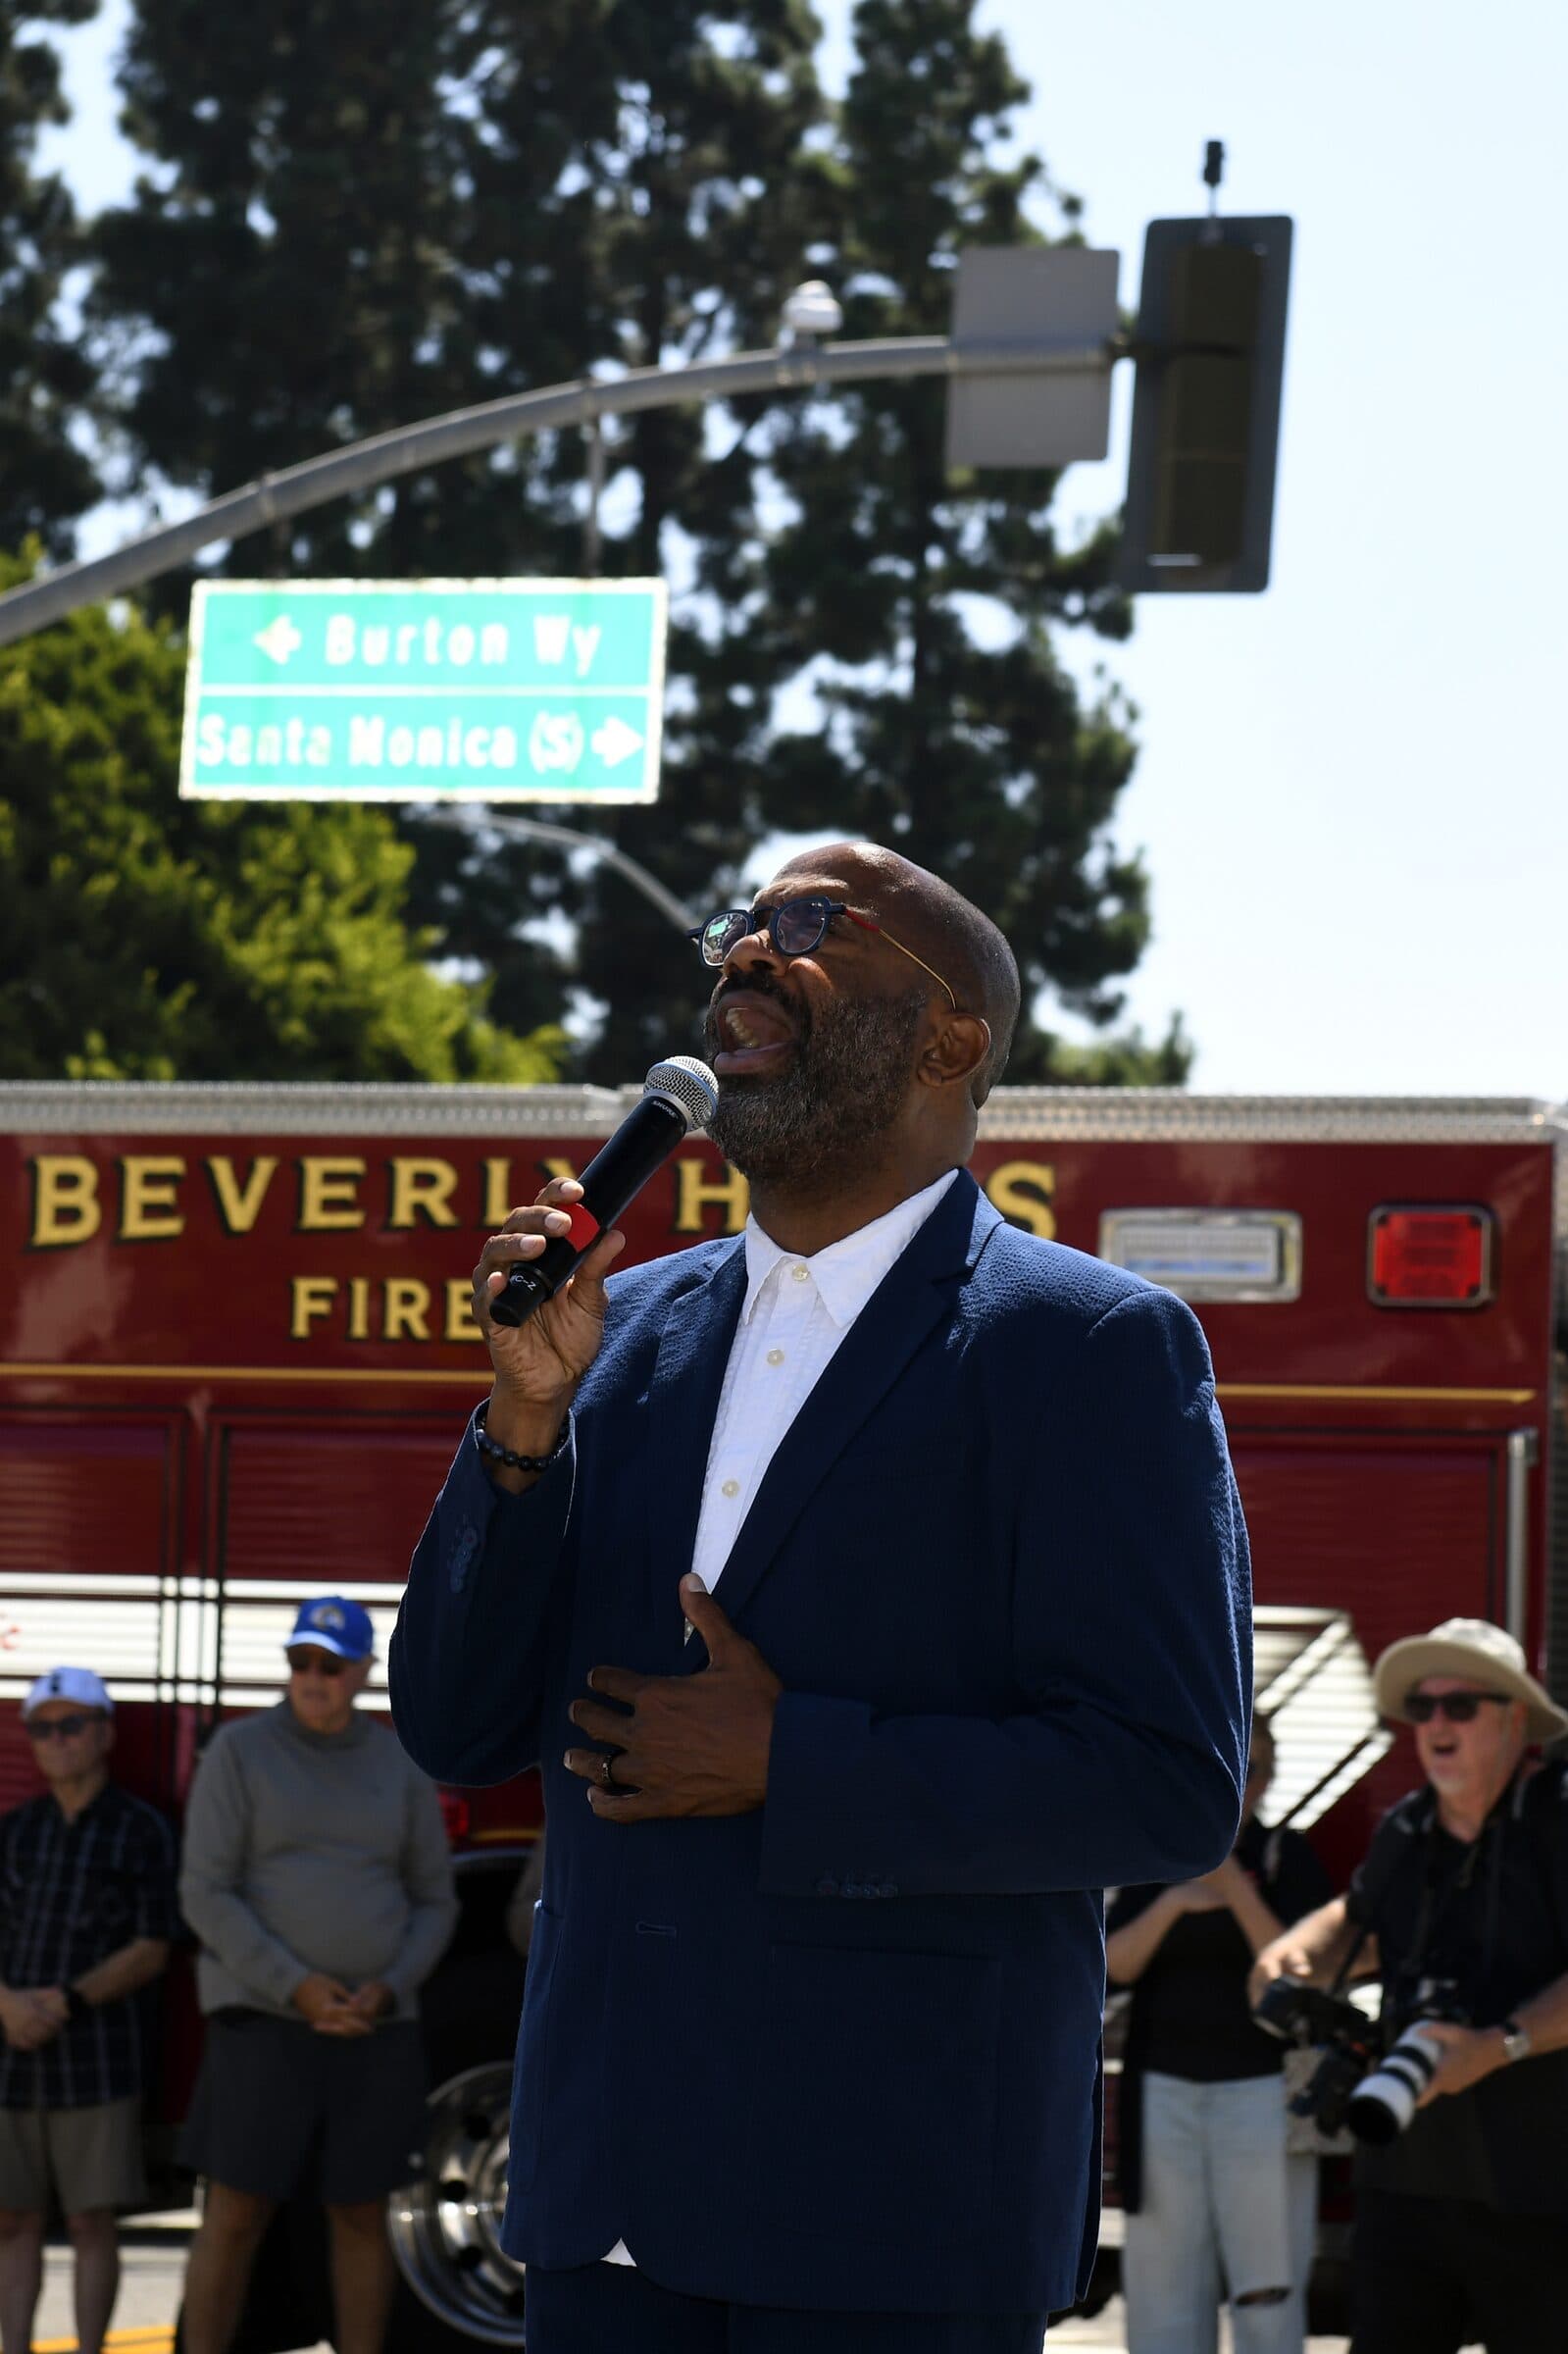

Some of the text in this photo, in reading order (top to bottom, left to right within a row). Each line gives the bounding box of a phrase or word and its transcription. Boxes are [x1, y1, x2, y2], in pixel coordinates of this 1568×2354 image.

[325, 614, 602, 676] Burton Wy
[197, 711, 584, 772] Santa Monica (S)
[32, 1155, 580, 1249] BEVERL
[293, 1277, 484, 1341] FIRE
